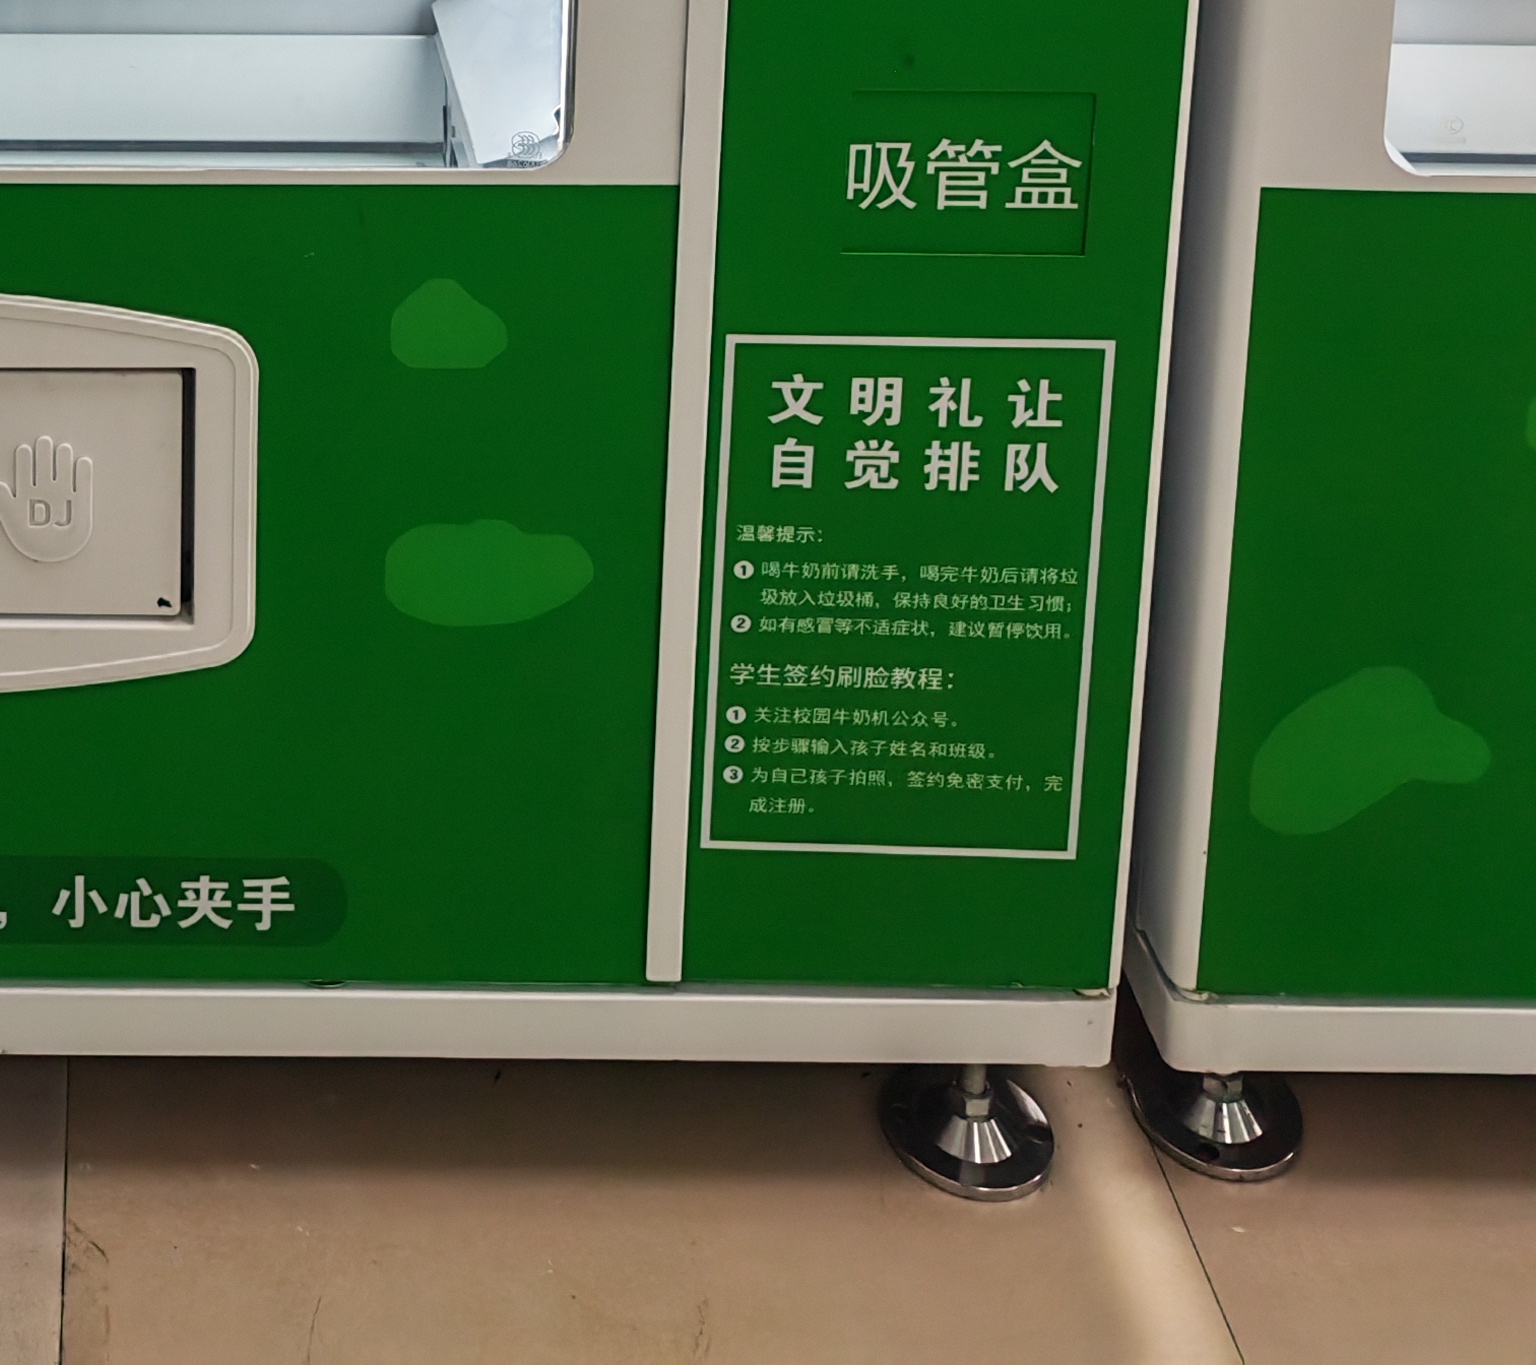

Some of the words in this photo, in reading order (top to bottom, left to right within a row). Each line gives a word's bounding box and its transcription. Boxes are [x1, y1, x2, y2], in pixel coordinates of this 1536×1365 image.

[845, 138, 1083, 211] 吸管盒
[767, 372, 1064, 429] 文明礼让
[770, 437, 1060, 494] 自觉排队
[735, 524, 824, 544] 温馨提示:
[760, 561, 1079, 586] 喝牛奶前请洗手，喝完牛奶后请将垃
[729, 662, 955, 691] 学生签约刷脸教程:
[754, 707, 960, 728] 关注校园牛奶机公众号。
[752, 737, 995, 760] 按步骤输入孩子姓名和班级。
[748, 796, 815, 815] 成注册。
